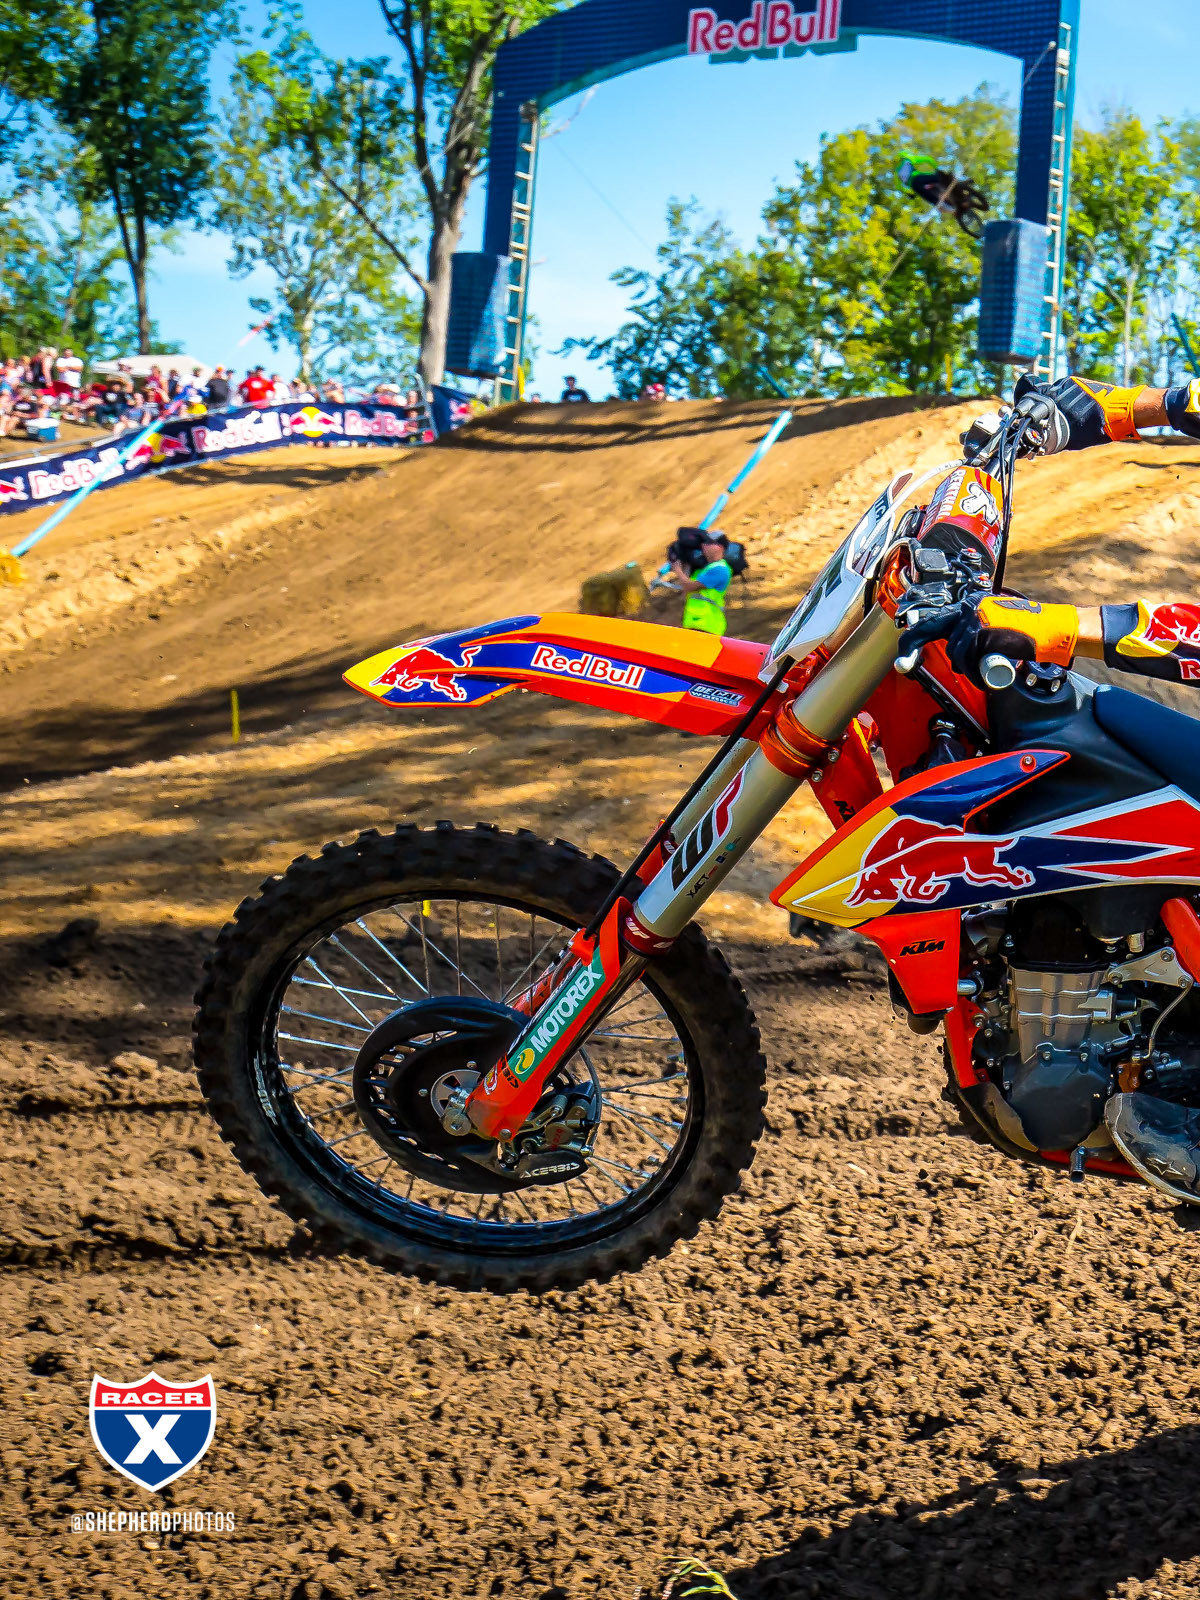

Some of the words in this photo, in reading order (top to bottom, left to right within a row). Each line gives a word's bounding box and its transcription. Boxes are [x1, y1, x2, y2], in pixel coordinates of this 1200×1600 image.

[688, 1, 764, 54] Red
[765, 0, 841, 48] Bull
[191, 419, 239, 453] Red
[238, 410, 282, 446] Bull
[344, 410, 383, 436] Red
[28, 460, 79, 499] Red
[530, 645, 593, 677] Red
[589, 654, 646, 690] Bull
[686, 873, 710, 898] XACT
[900, 939, 946, 956] KTM
[530, 963, 602, 1054] MOTOREX
[520, 1162, 580, 1179] ACERBIS
